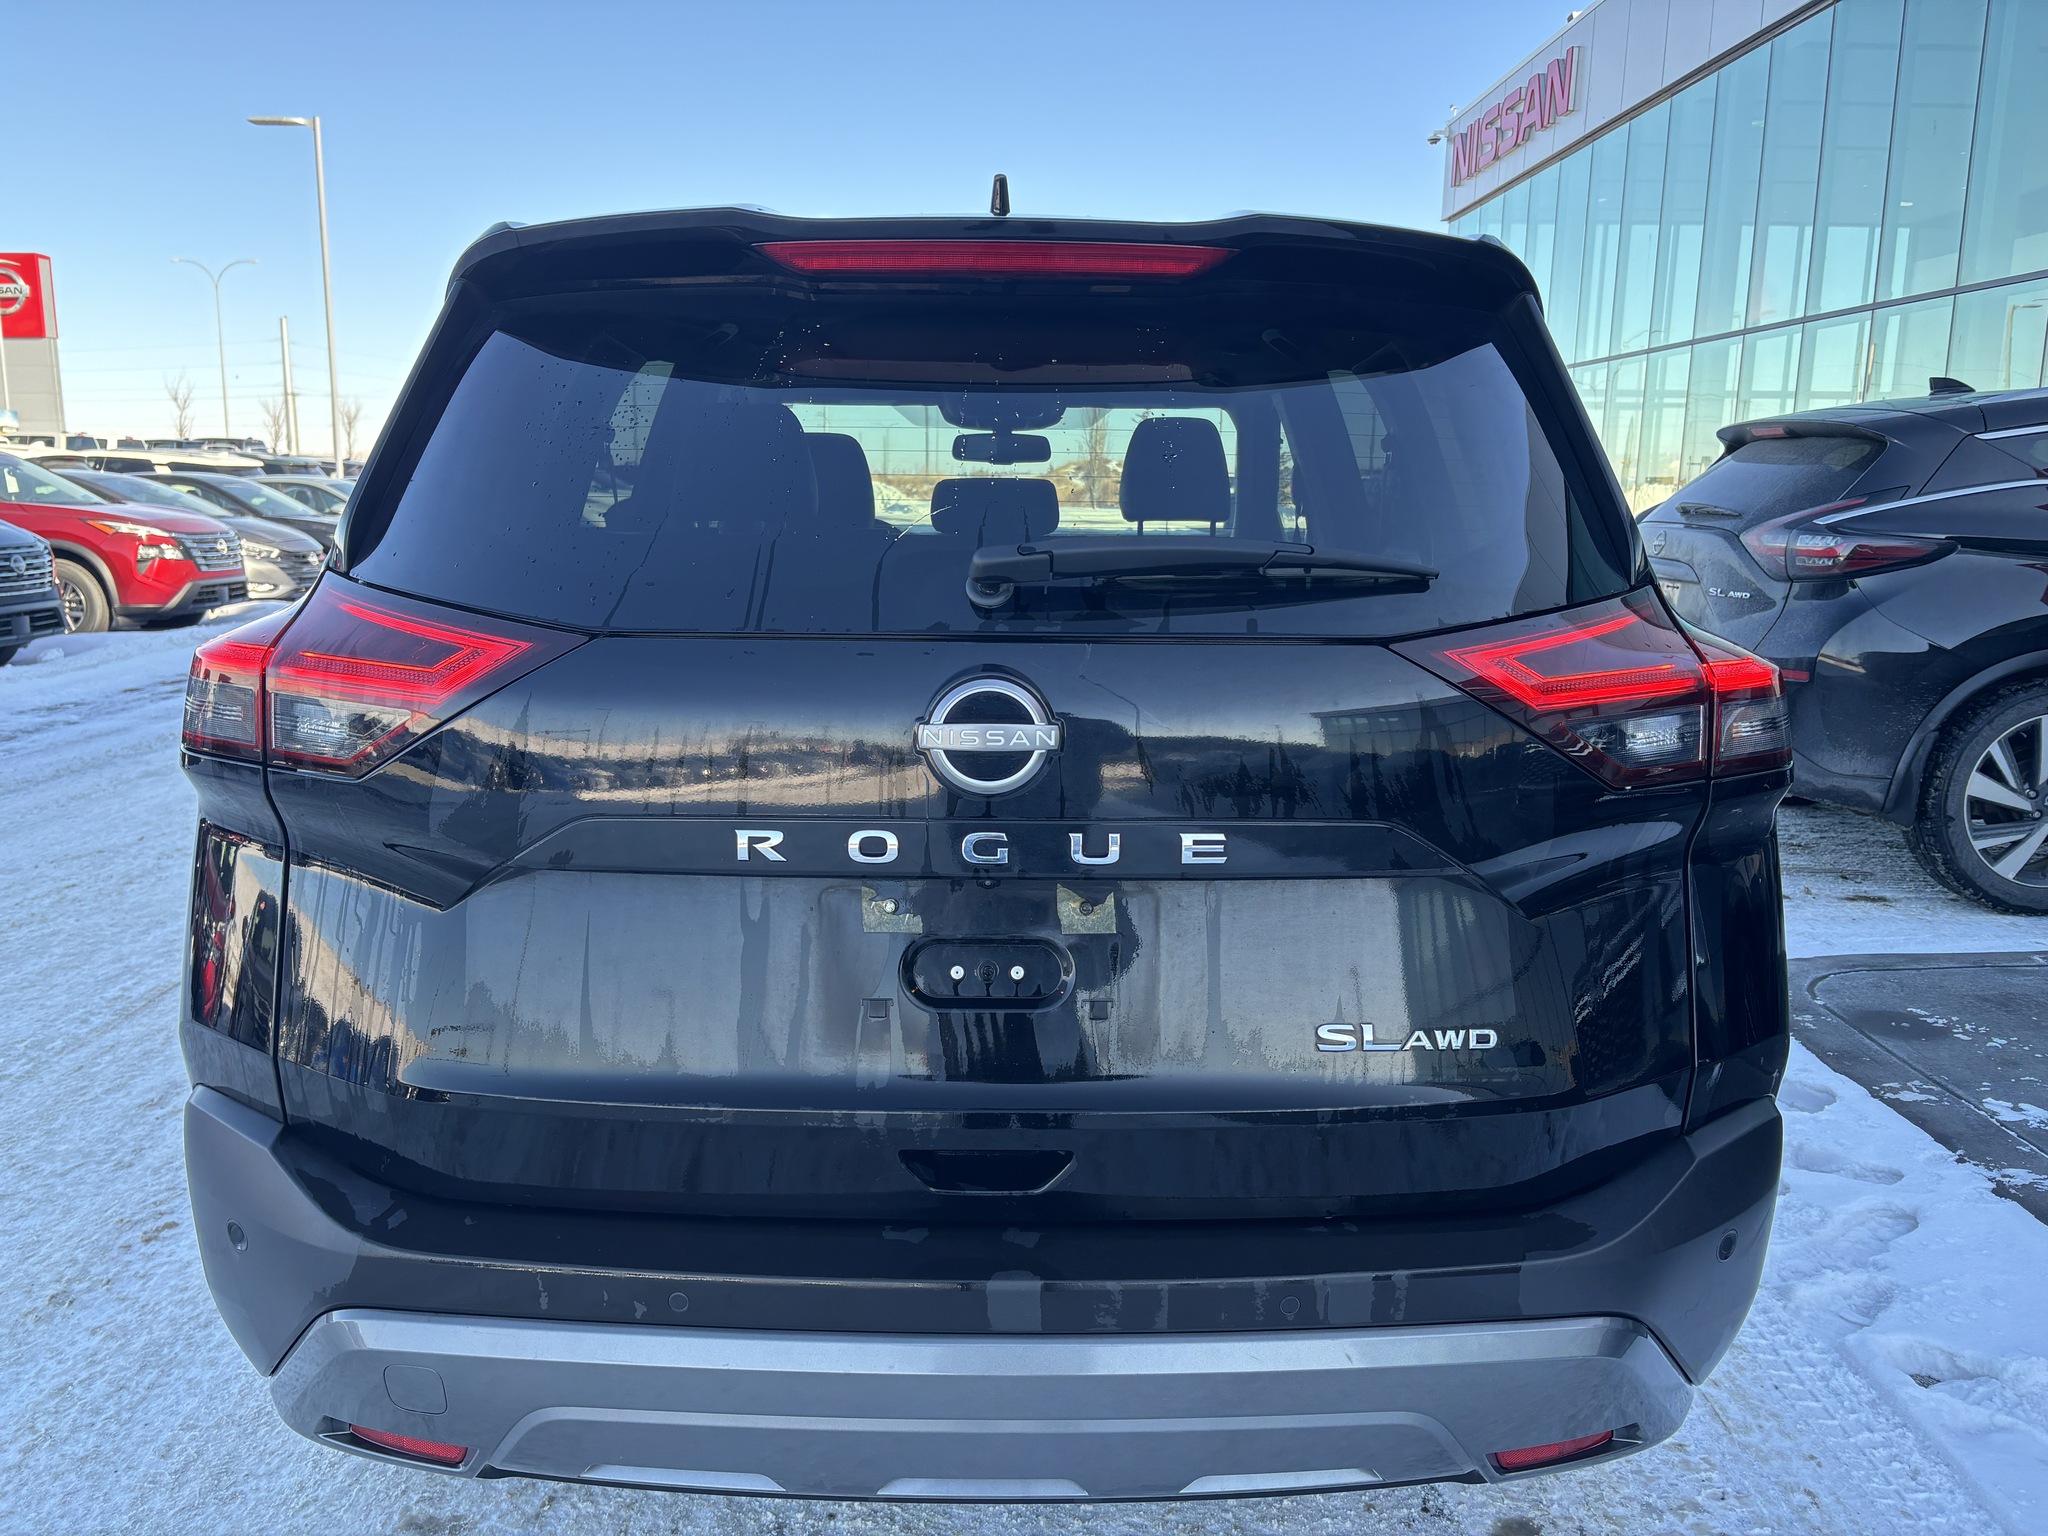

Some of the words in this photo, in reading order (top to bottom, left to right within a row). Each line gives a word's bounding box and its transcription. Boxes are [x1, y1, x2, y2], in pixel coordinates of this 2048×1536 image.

[1451, 46, 1579, 188] NISSAN
[1708, 587, 1726, 597] SL
[923, 729, 1056, 746] NISSAN
[735, 829, 1228, 865] ROGUE
